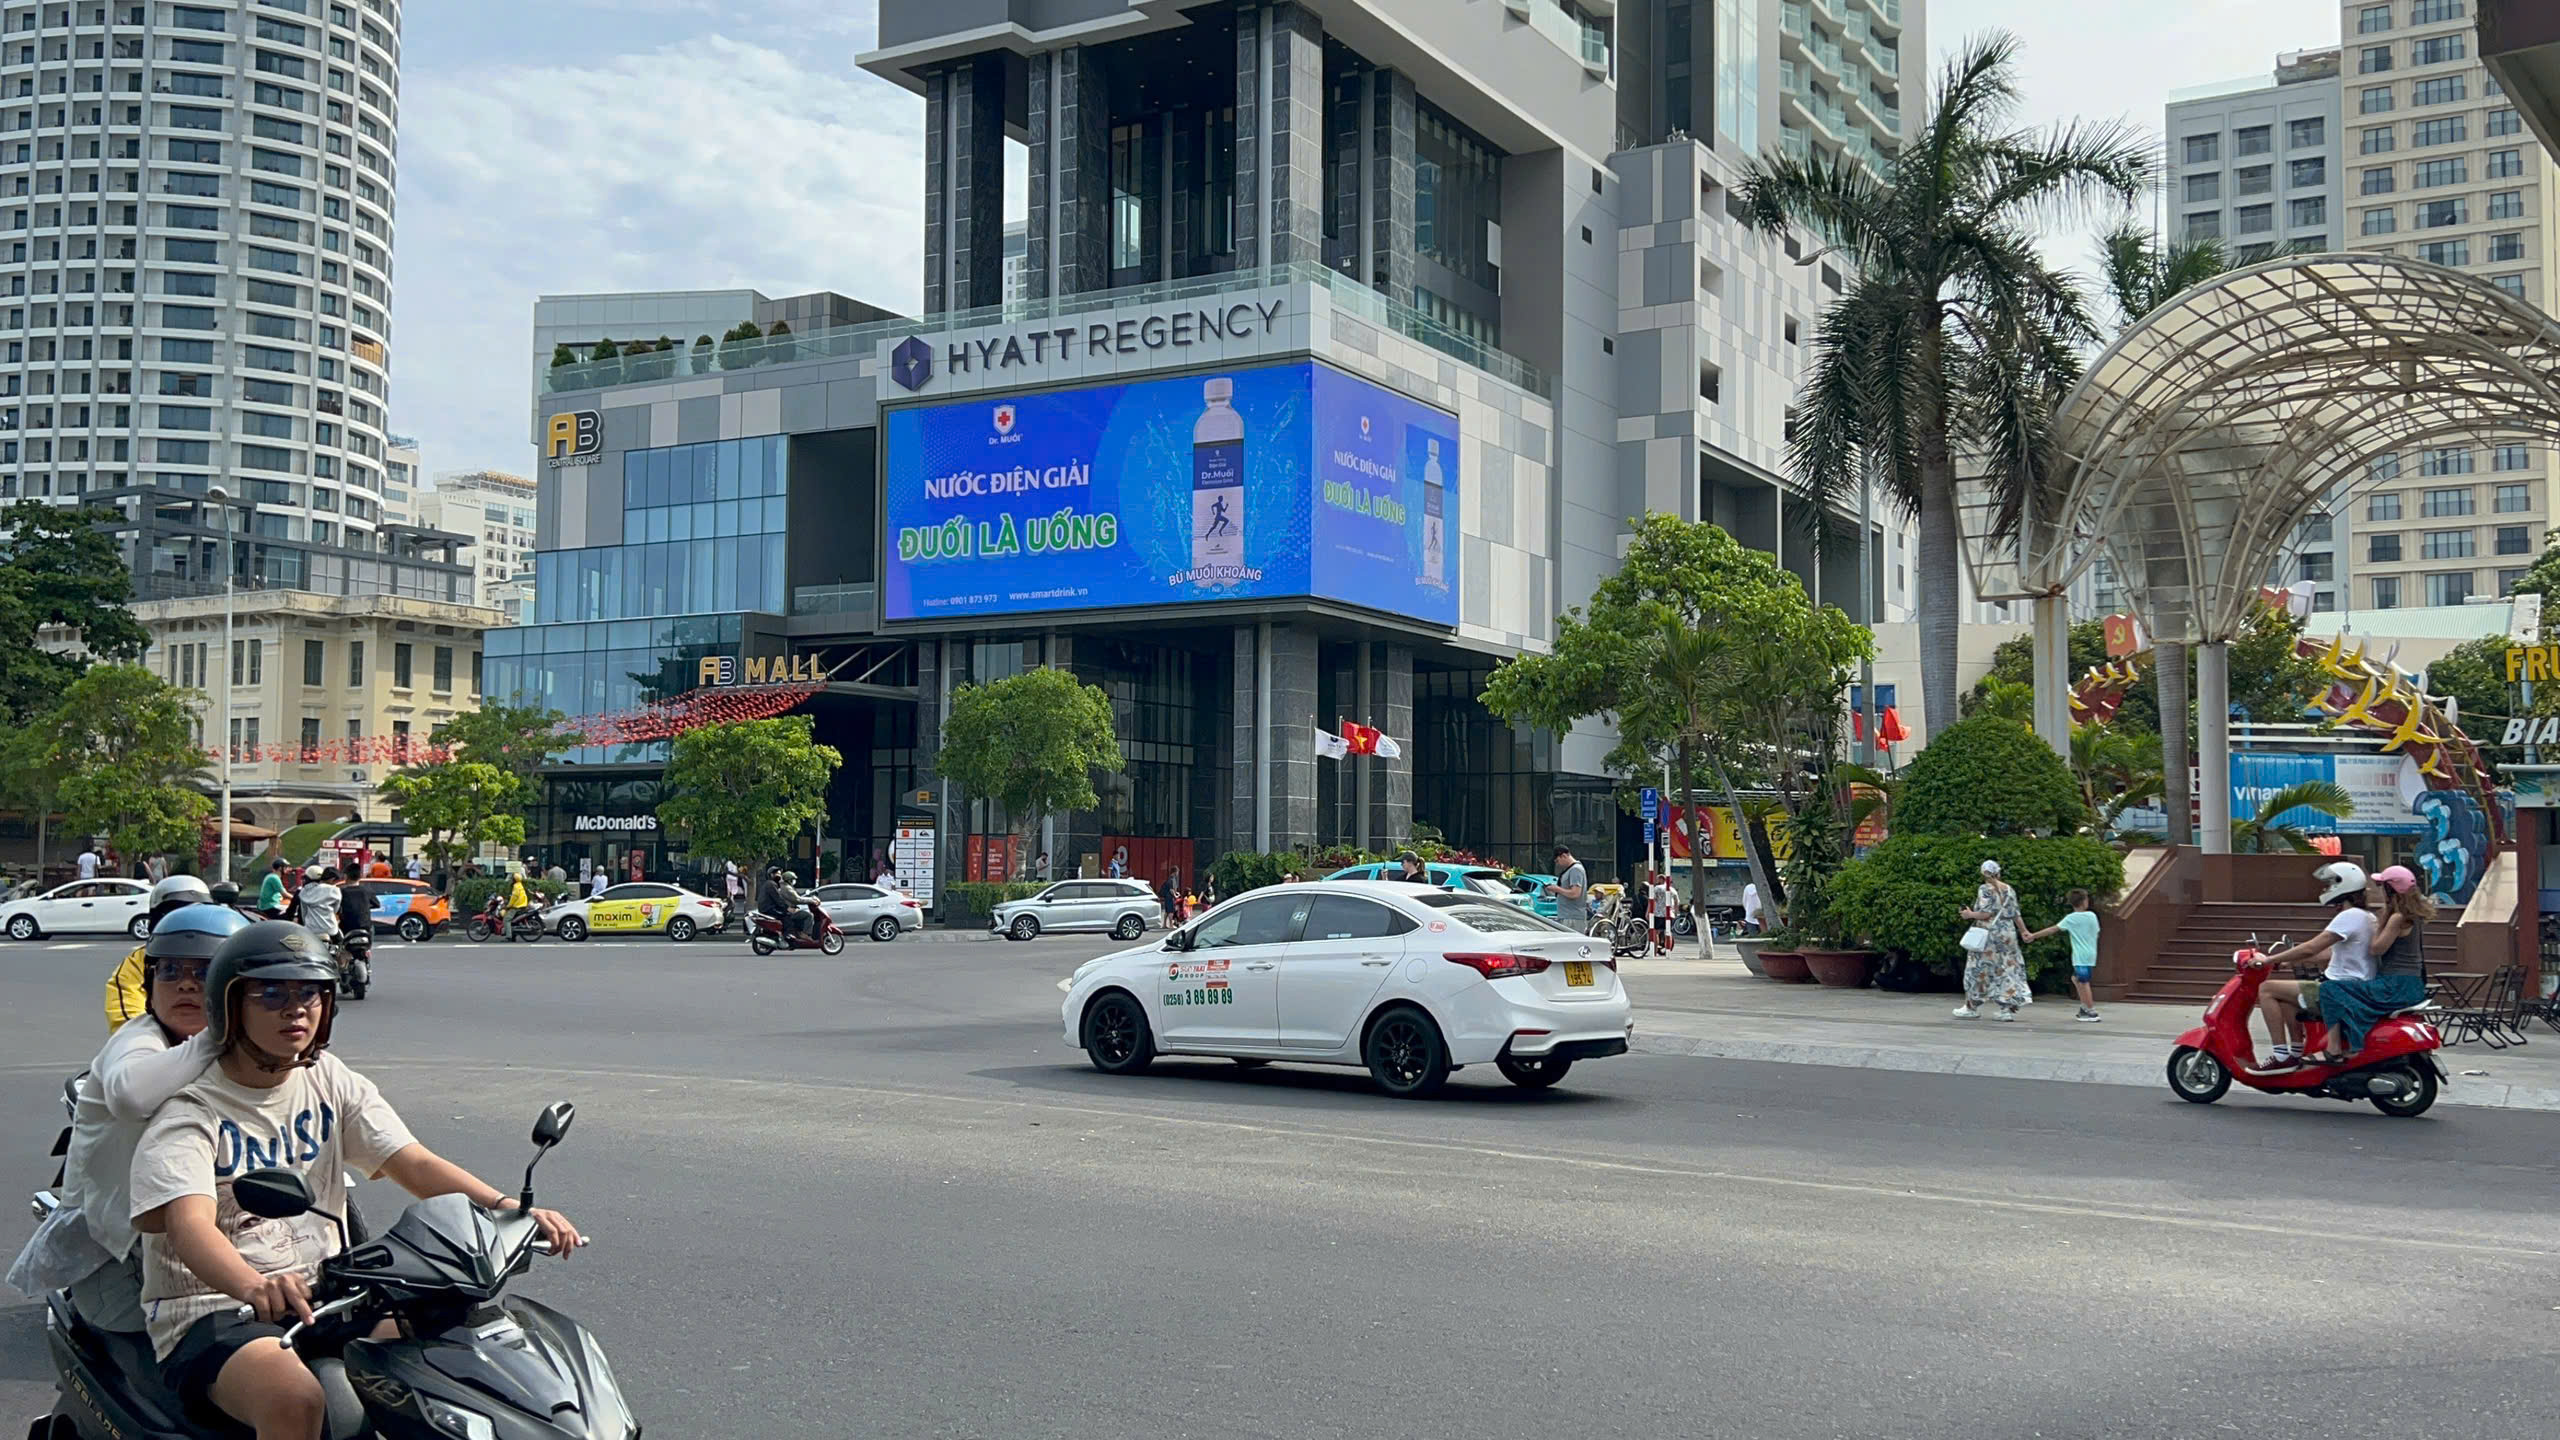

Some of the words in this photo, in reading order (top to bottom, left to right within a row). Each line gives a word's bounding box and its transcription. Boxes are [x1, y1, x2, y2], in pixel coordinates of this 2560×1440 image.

[948, 327, 1076, 374] HYATT
[1089, 299, 1281, 357] REGENCY
[547, 408, 601, 457] AB
[925, 470, 987, 499] NƯỚC
[991, 466, 1040, 496] ĐIỆN
[1044, 458, 1090, 488] GIẢI
[898, 514, 971, 561] ĐUỐI
[979, 513, 1020, 555] LÀ
[1026, 506, 1117, 552] UỐNG
[1168, 570, 1184, 587] BÙ
[1185, 563, 1214, 582] MUỐI
[1216, 564, 1262, 581] KHOÁNG
[699, 655, 737, 686] AB
[744, 653, 827, 684] MALL
[575, 815, 657, 830] McDonald's
[594, 911, 632, 921] maxim
[1186, 989, 1192, 1005] 3
[1194, 989, 1205, 1005] 89
[1208, 989, 1219, 1005] 89
[1221, 988, 1233, 1005] 89
